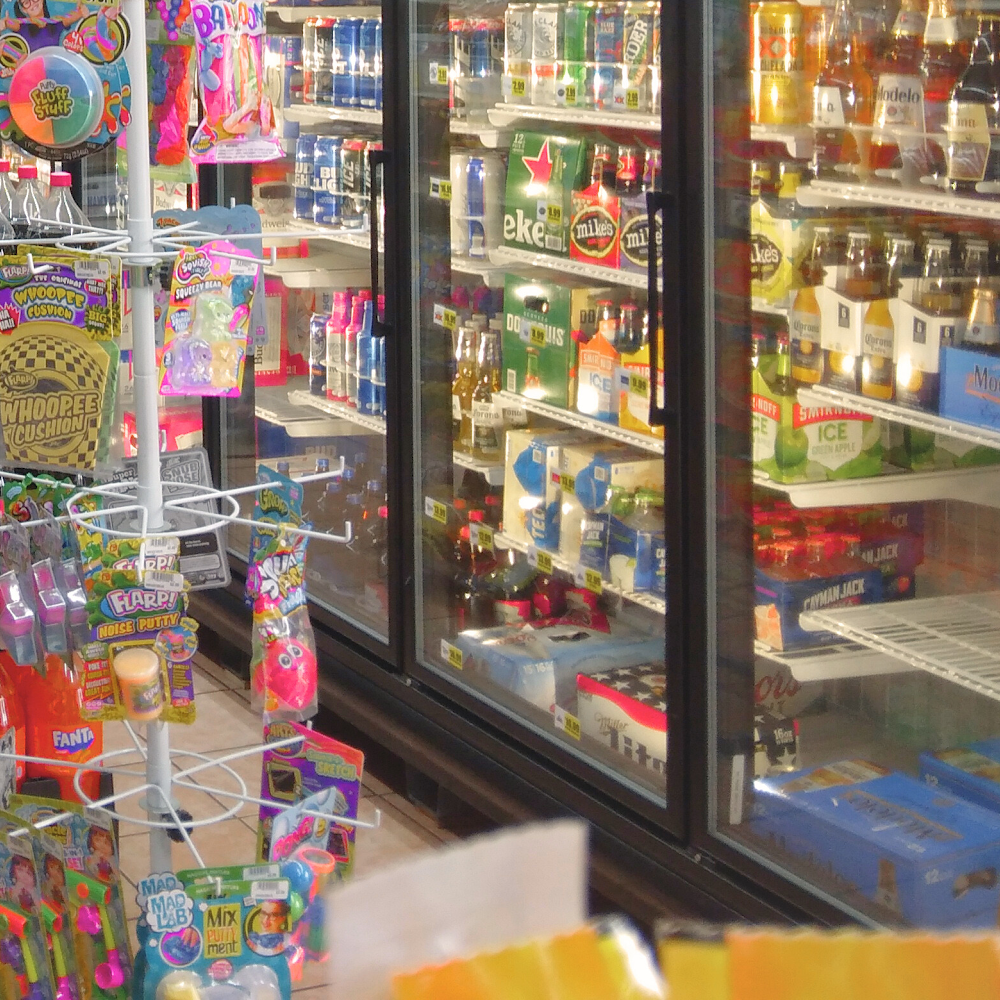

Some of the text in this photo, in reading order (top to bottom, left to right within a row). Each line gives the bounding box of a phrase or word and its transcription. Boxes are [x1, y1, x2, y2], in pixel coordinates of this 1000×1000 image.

[31, 86, 69, 105] FLUFF
[34, 102, 71, 120] STUFF
[514, 133, 524, 145] 12
[575, 220, 615, 240] mike's
[2, 264, 30, 279] FLARP!
[13, 285, 86, 309] WHOOPEE
[175, 280, 222, 300] SQUEEZY BEAR
[0, 308, 10, 321] HA
[27, 304, 73, 320] CUSHION
[88, 310, 107, 323] BIG
[840, 306, 848, 318] 6
[793, 320, 893, 349] Corona Corona
[589, 372, 611, 392] ICE
[0, 393, 99, 426] WHOOPEE
[15, 414, 85, 446] CUSHION
[818, 421, 848, 443] ICE
[812, 442, 857, 455] GREEN APPLE
[162, 462, 199, 480] SNUB
[874, 543, 899, 562] JACK
[107, 590, 178, 616] FLARP!
[803, 577, 865, 612] CAYMAN JACK
[98, 612, 180, 640] NOISE PUTTY
[52, 726, 95, 748] FANTA
[317, 761, 357, 778] SKETCH
[150, 892, 186, 919] MAD
[155, 908, 188, 930] LAB
[206, 905, 238, 928] Mix
[206, 926, 237, 943] PUTTY
[206, 941, 238, 956] ment
